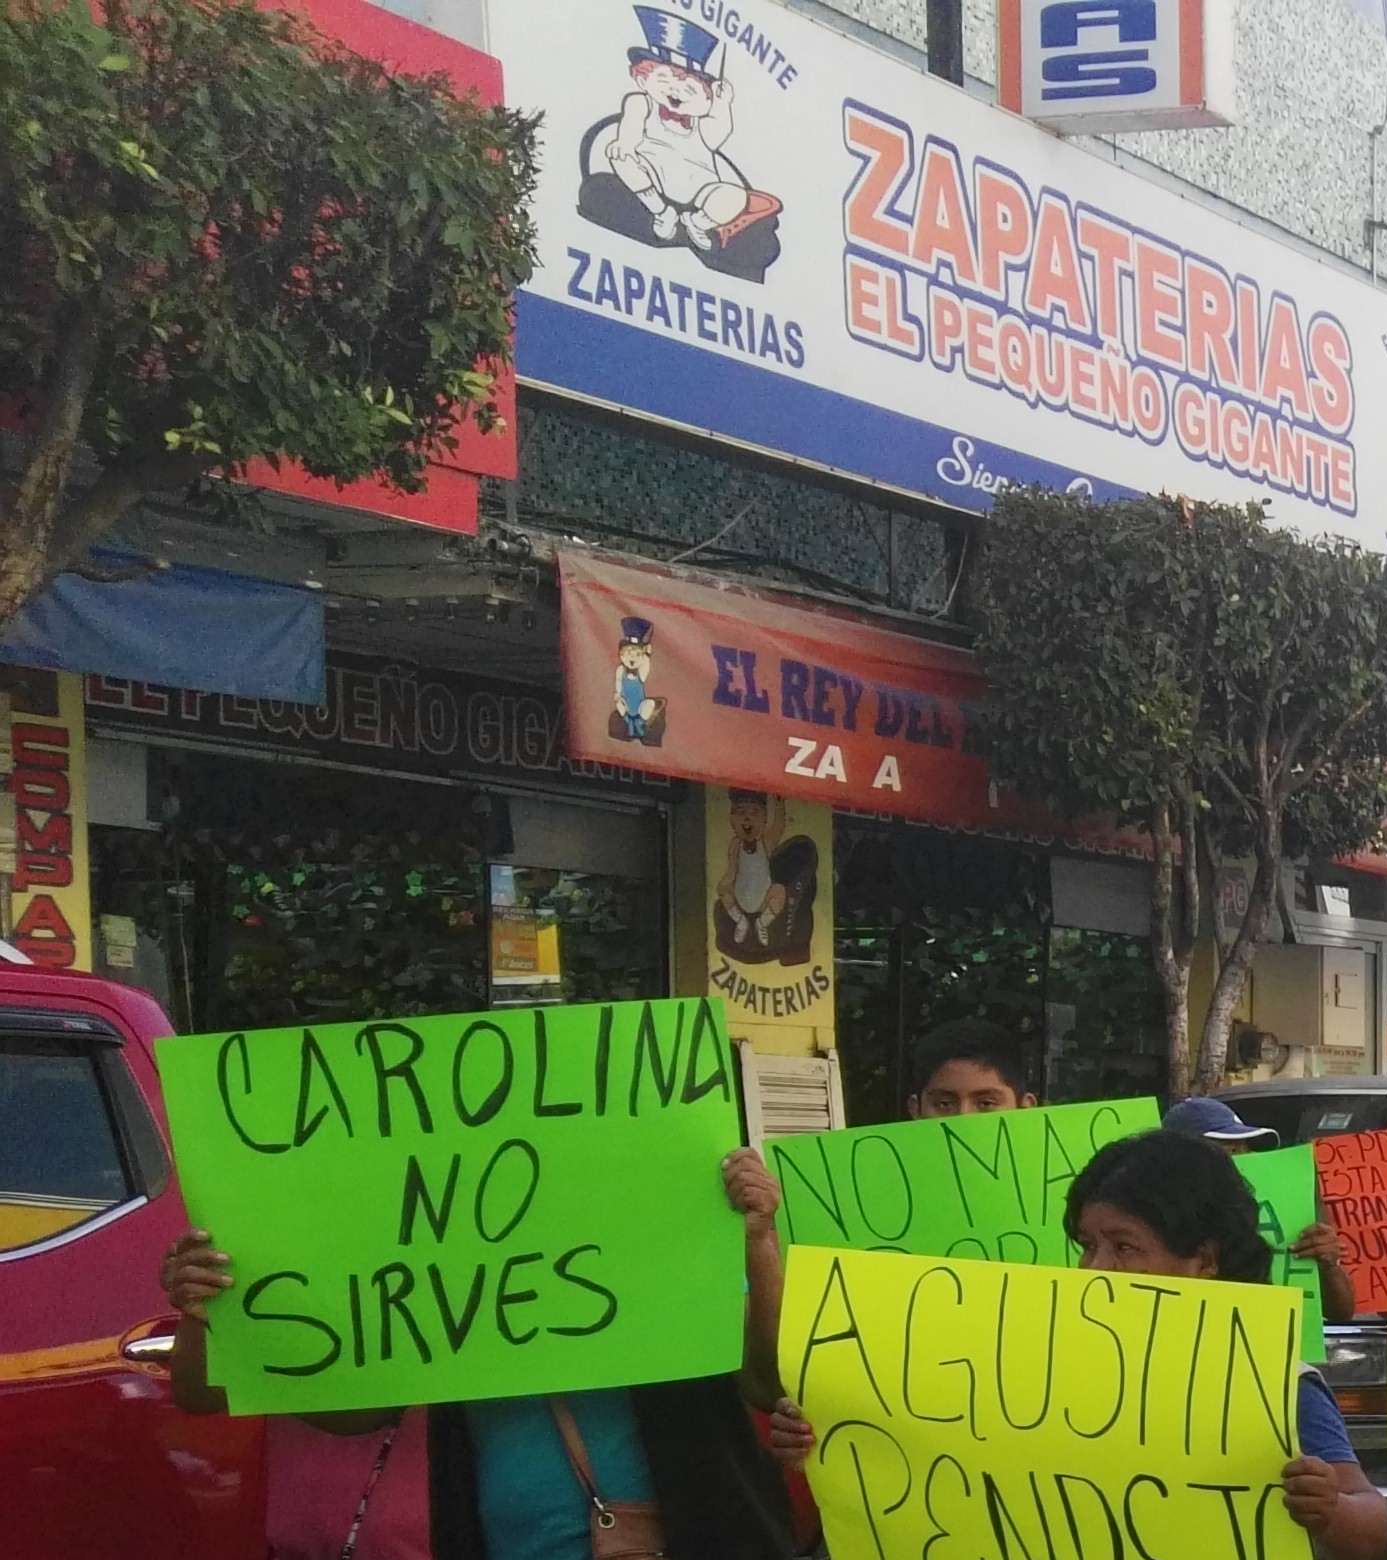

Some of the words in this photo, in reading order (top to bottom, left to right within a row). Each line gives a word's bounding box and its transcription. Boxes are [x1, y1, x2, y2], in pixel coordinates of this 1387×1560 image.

[699, 0, 798, 90] GIGANTE
[567, 247, 805, 369] ZAPATERIAS
[844, 98, 1354, 435] ZAPATERIAS
[845, 246, 924, 362] EL
[927, 280, 1168, 445] PEQUEÑO
[1174, 372, 1356, 518] GIGANTE
[711, 645, 770, 714] EL
[780, 658, 864, 732] REY
[875, 683, 954, 748] DEL
[710, 958, 830, 1017] ZAPATERIAS
[216, 1000, 733, 1154] CAROLINA
[400, 1138, 540, 1247] NO
[772, 1134, 913, 1245] NO
[1318, 1165, 1387, 1198] ESTA
[242, 1244, 618, 1377] SIRVES
[797, 1256, 1296, 1458] AGUSTIN
